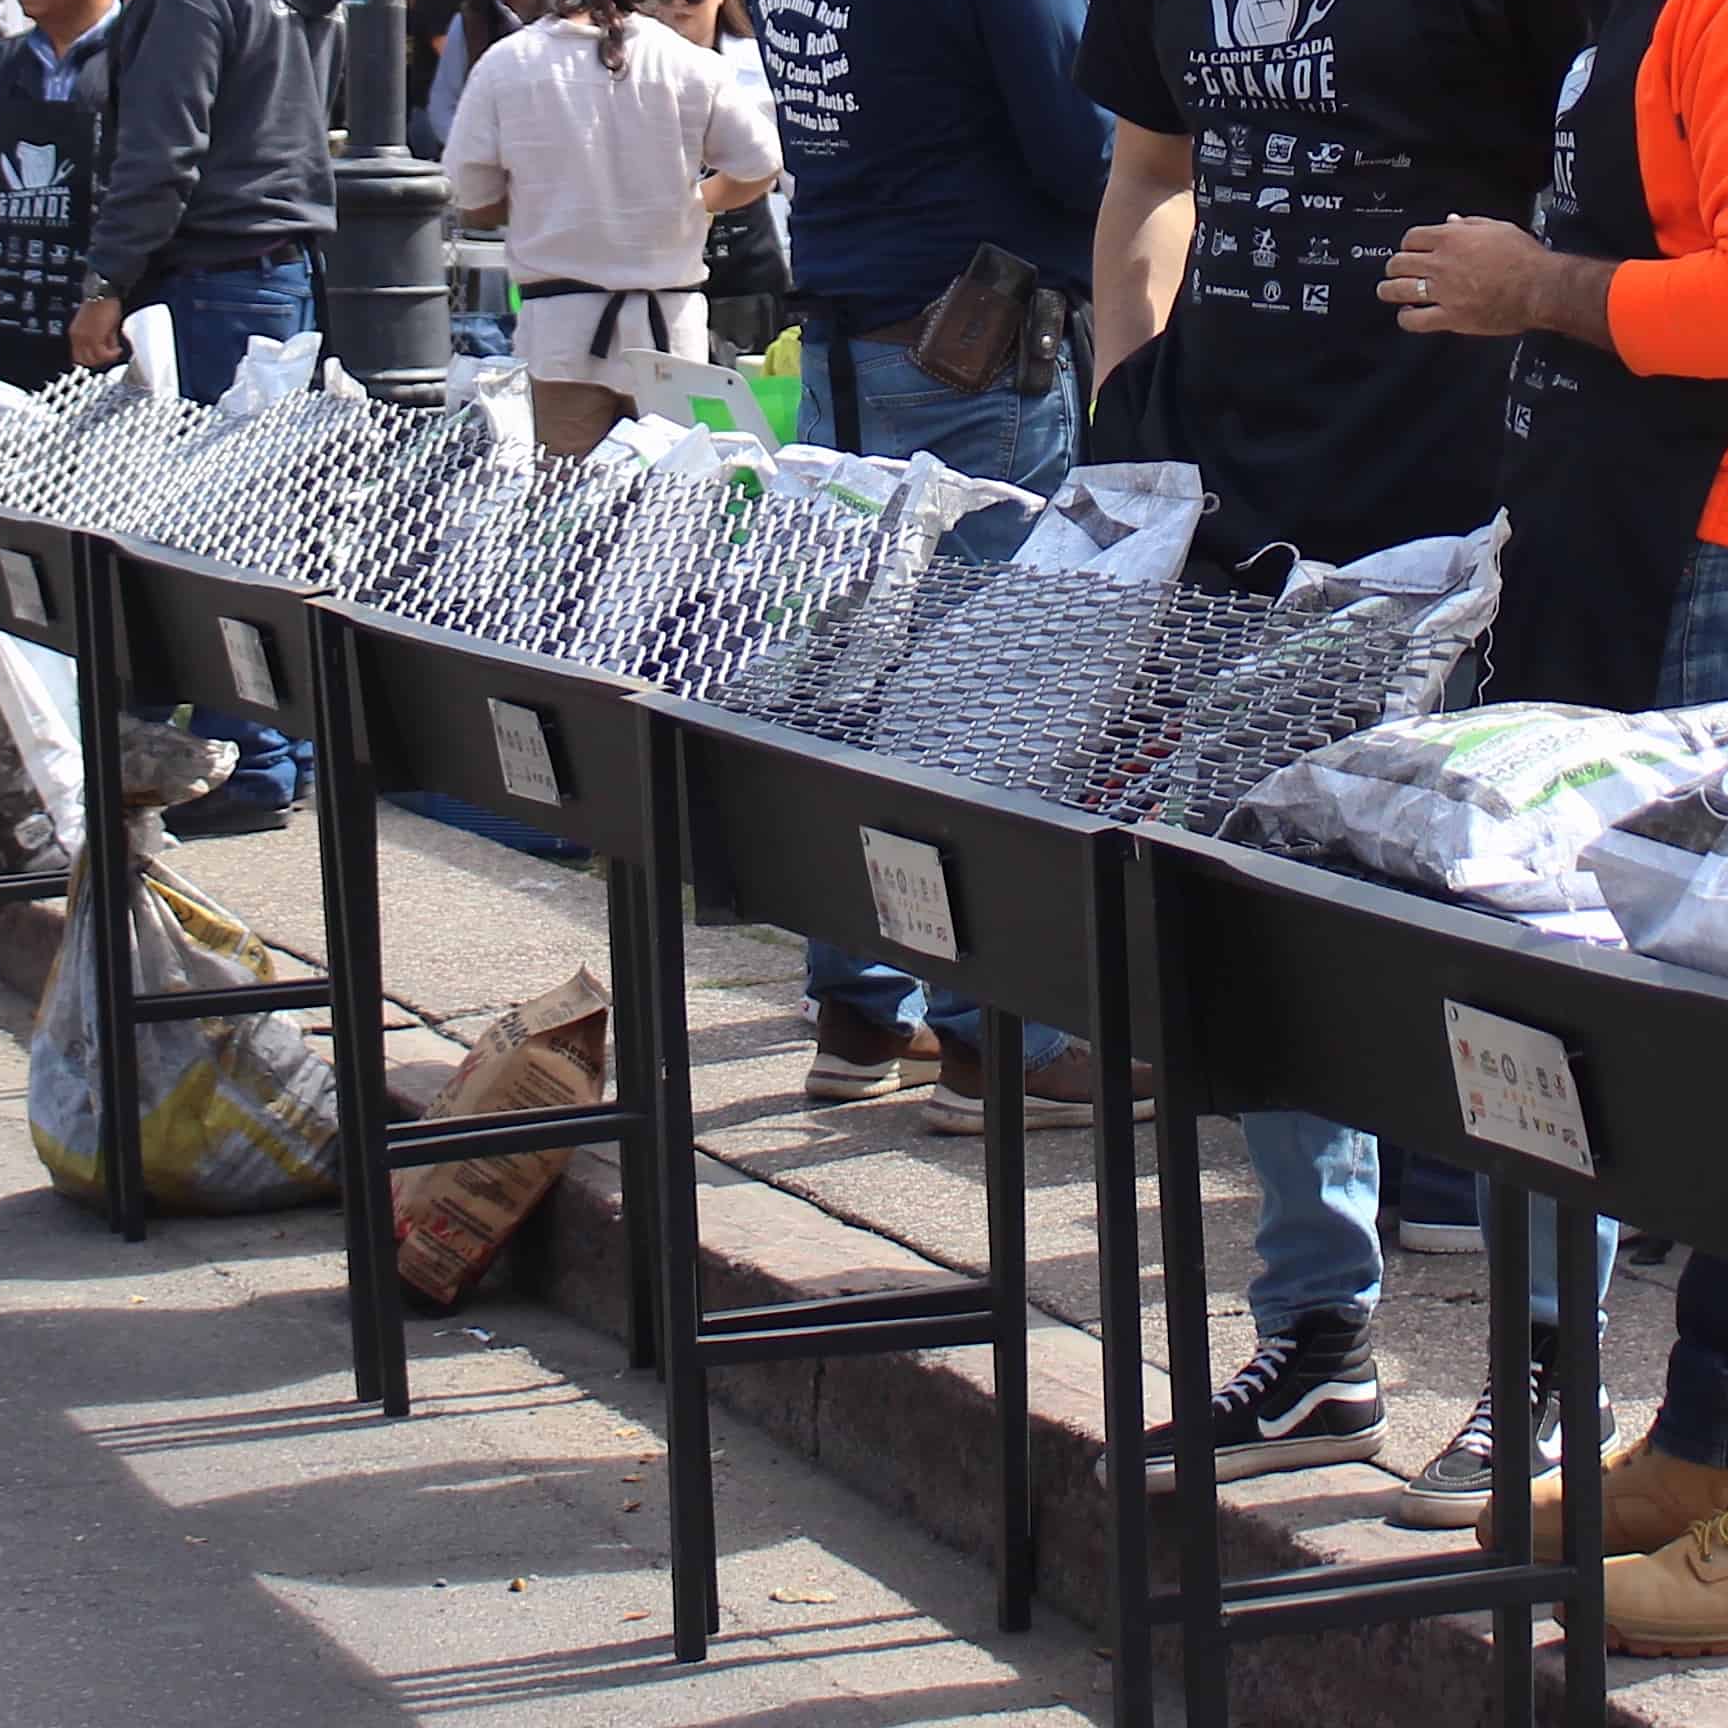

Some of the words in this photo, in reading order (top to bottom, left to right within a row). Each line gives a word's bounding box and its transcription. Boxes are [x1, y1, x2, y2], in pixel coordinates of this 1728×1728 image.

[806, 29, 839, 56] Ruth
[1189, 50, 1207, 64] LA
[1210, 49, 1265, 64] CARNE
[1271, 36, 1334, 61] ASADA
[821, 52, 849, 86] José
[1301, 194, 1344, 209] VOLT
[1364, 247, 1393, 257] MEGA
